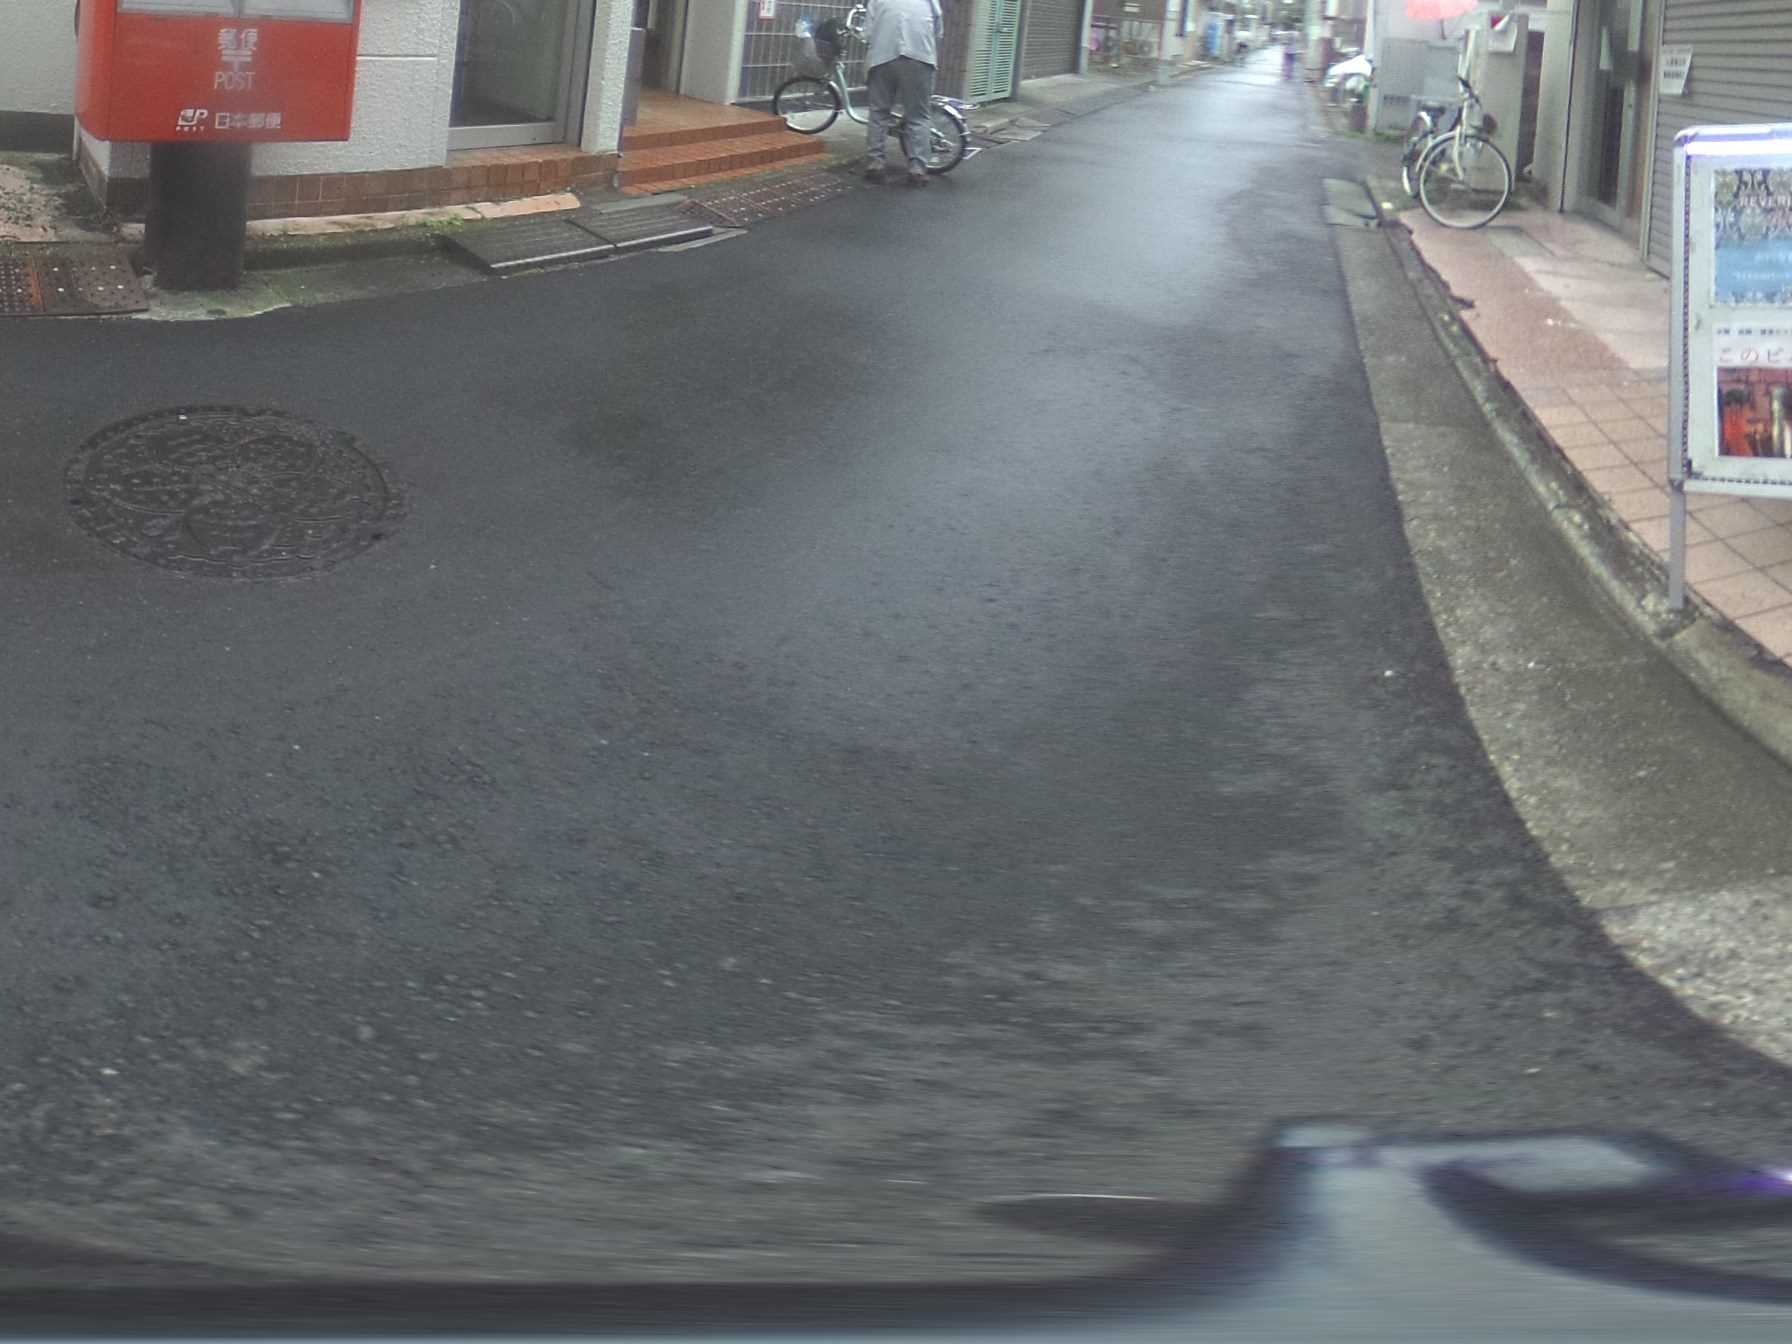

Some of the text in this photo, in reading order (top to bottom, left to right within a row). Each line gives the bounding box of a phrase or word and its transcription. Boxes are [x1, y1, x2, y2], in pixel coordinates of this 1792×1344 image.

[214, 71, 256, 91] POST
[215, 112, 281, 129] 日本郵便
